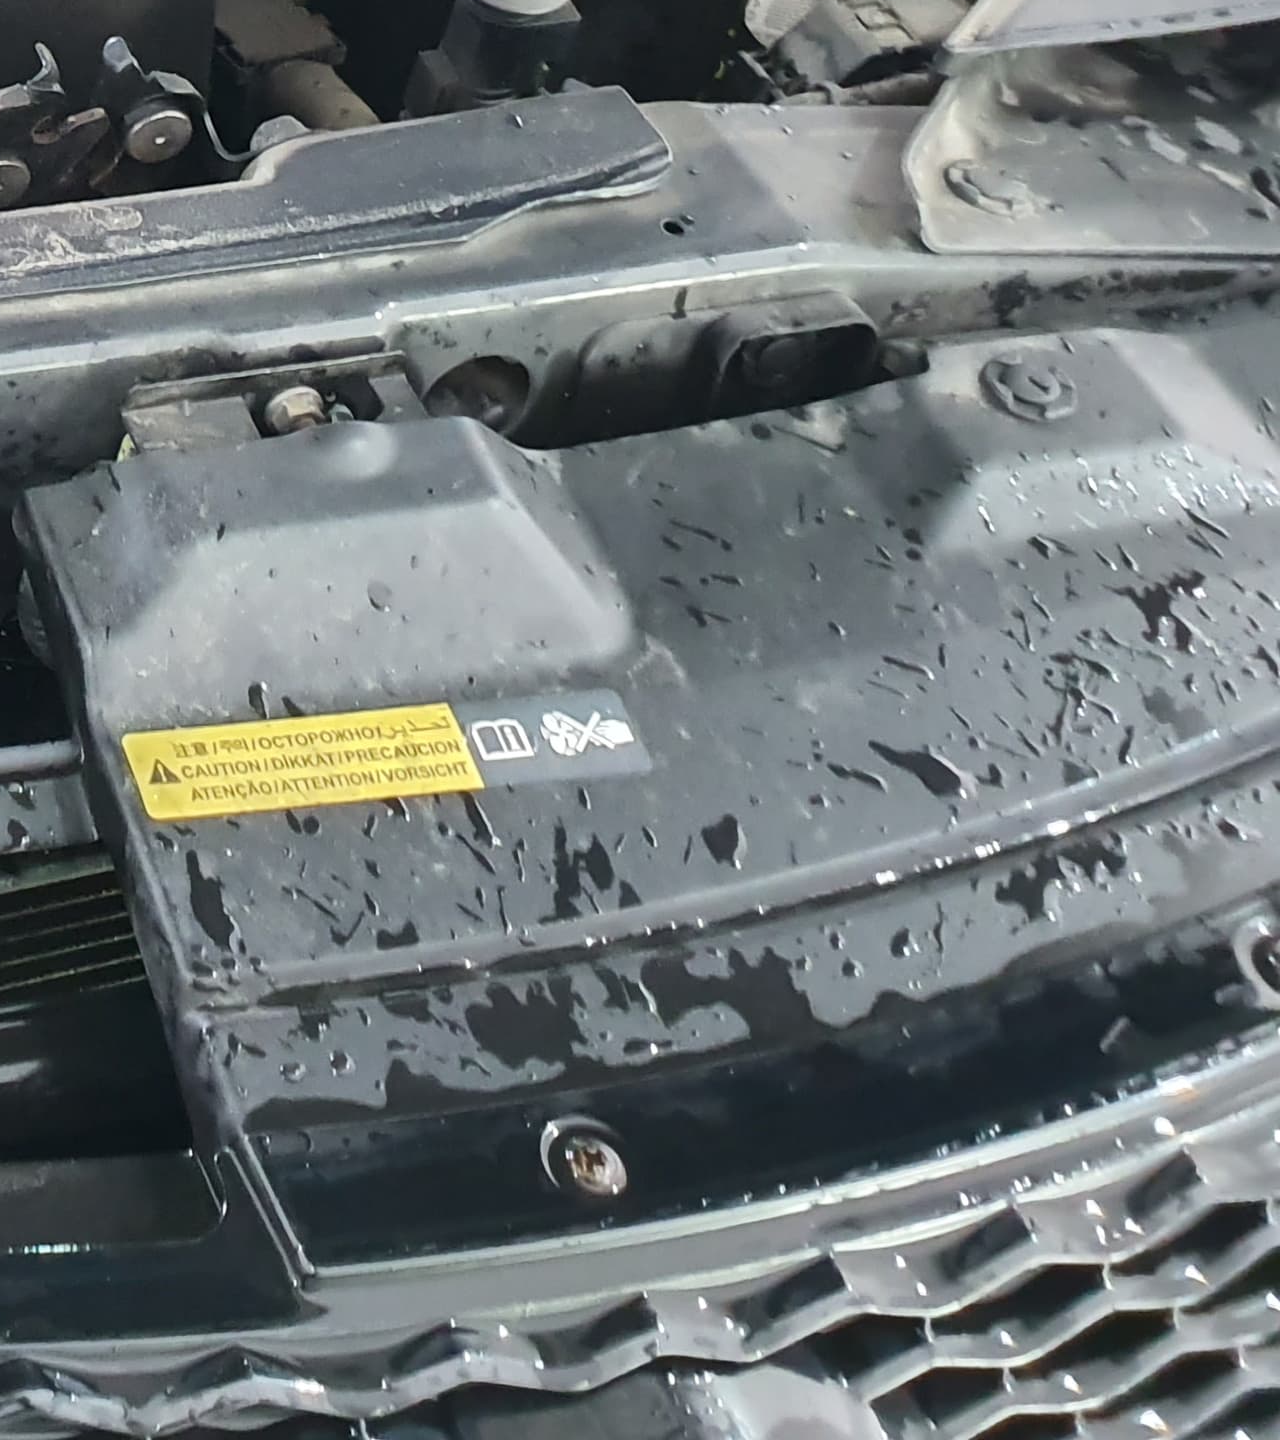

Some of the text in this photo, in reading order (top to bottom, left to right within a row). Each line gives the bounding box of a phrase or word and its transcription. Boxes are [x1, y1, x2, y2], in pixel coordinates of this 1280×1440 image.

[181, 760, 261, 781] CAUTION
[281, 771, 376, 793] ATTENTION
[382, 760, 469, 783] VORSICHT
